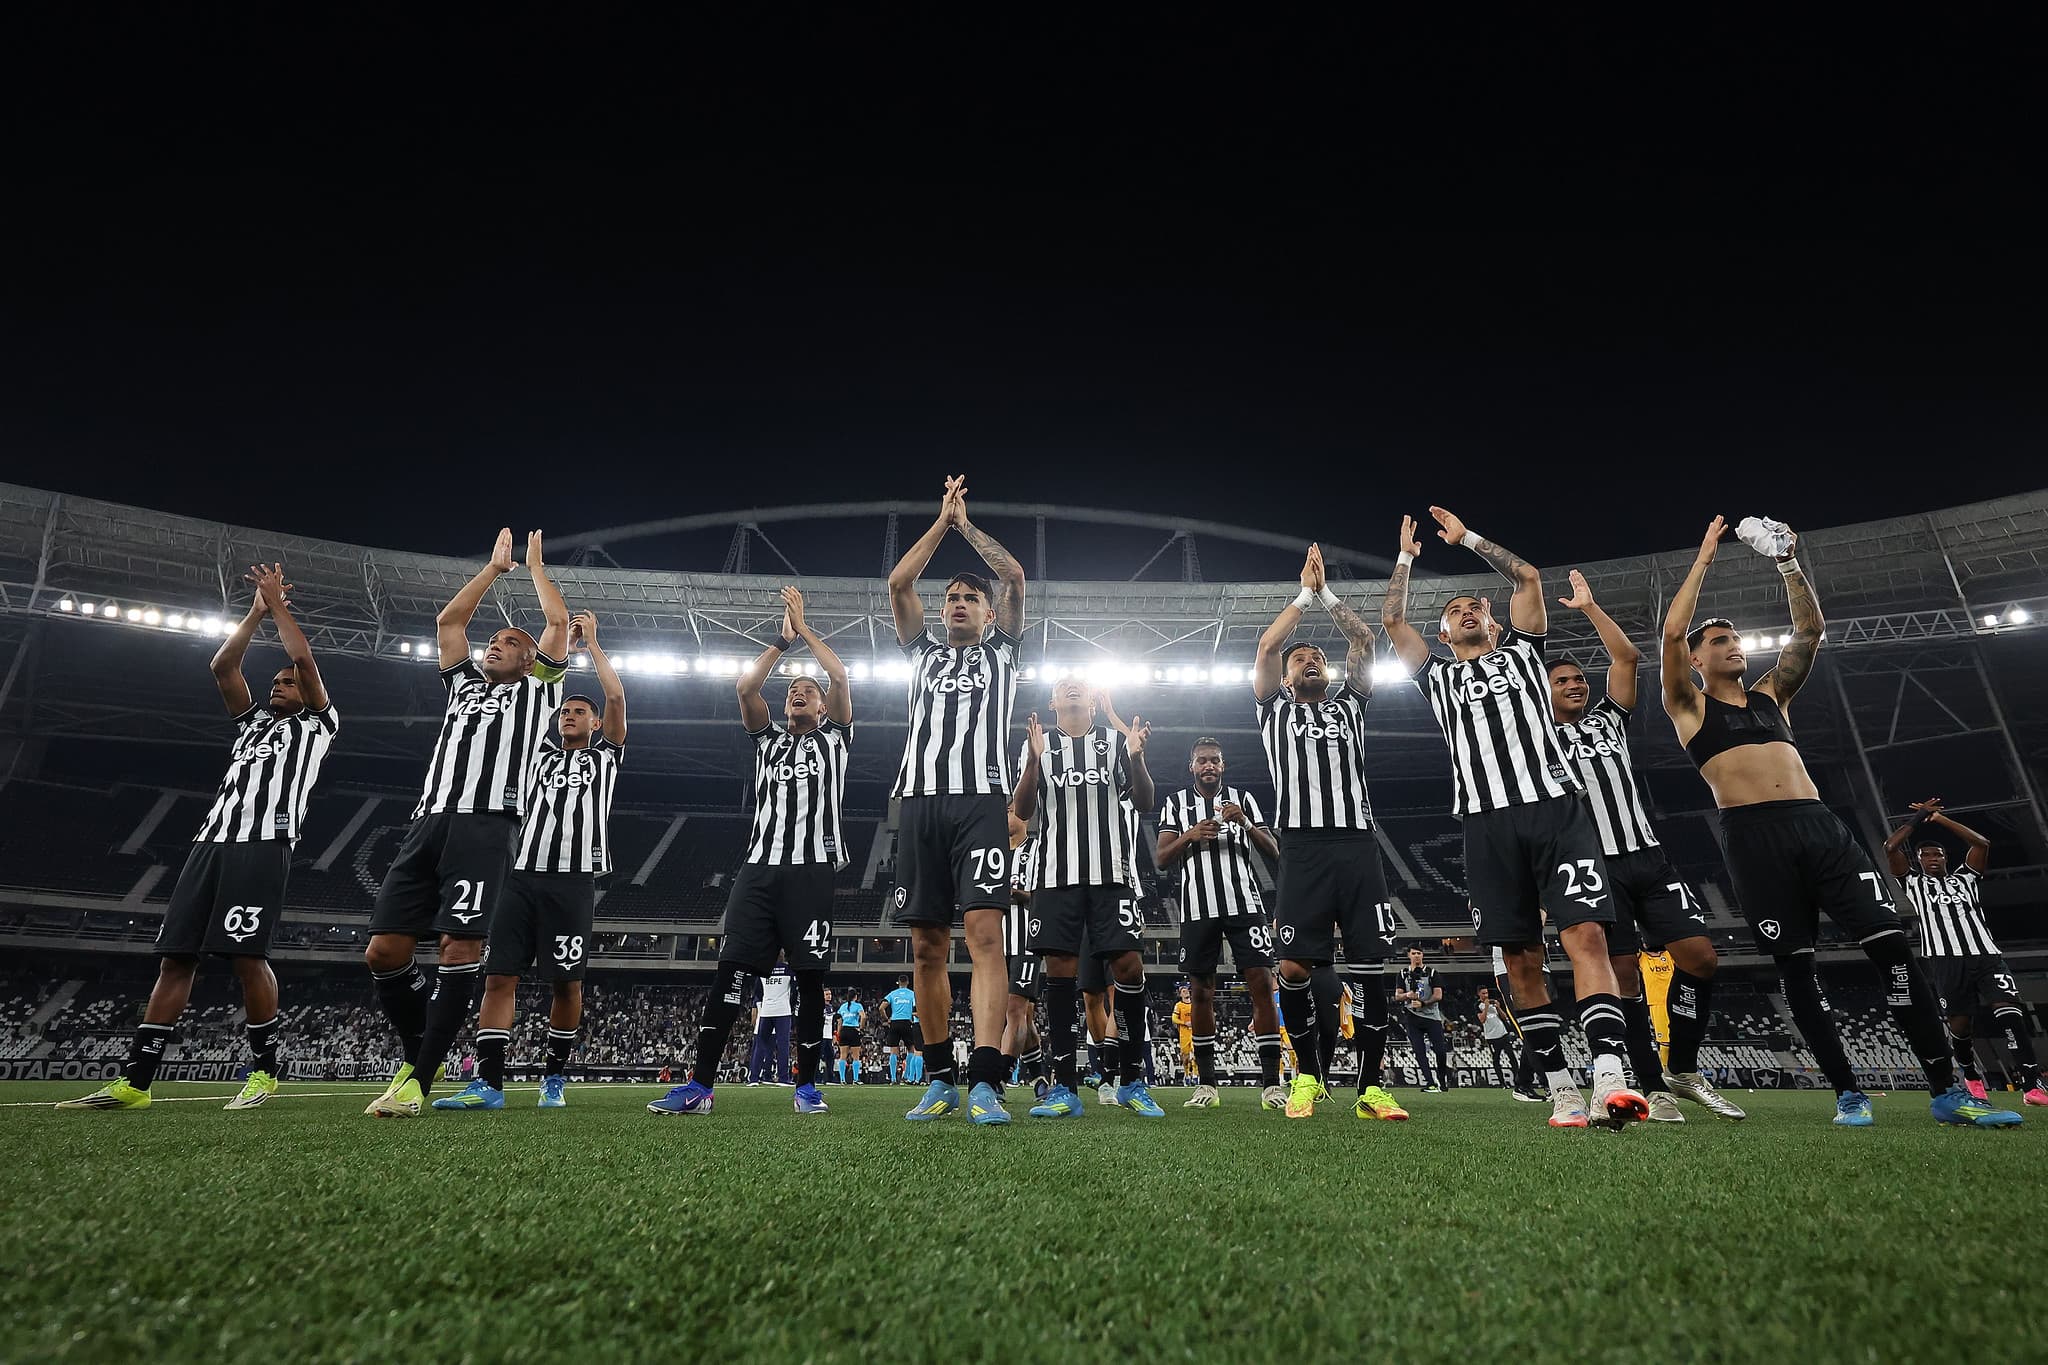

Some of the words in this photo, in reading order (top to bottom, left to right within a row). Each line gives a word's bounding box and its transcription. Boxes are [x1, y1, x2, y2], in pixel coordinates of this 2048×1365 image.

[927, 672, 986, 693] vbet
[1453, 668, 1520, 704] vbet
[1291, 720, 1348, 739] vbet
[1565, 739, 1621, 761] vbet
[1051, 766, 1110, 788] vbet
[970, 848, 1005, 880] 79
[1557, 859, 1603, 896] 23
[451, 880, 485, 911] 21
[1927, 891, 1968, 905] vbet
[224, 905, 264, 933] 63
[1374, 903, 1396, 932] 13
[802, 919, 831, 948] 42
[1249, 926, 1273, 948] 88
[553, 935, 584, 960] 38
[1020, 962, 1035, 981] 11
